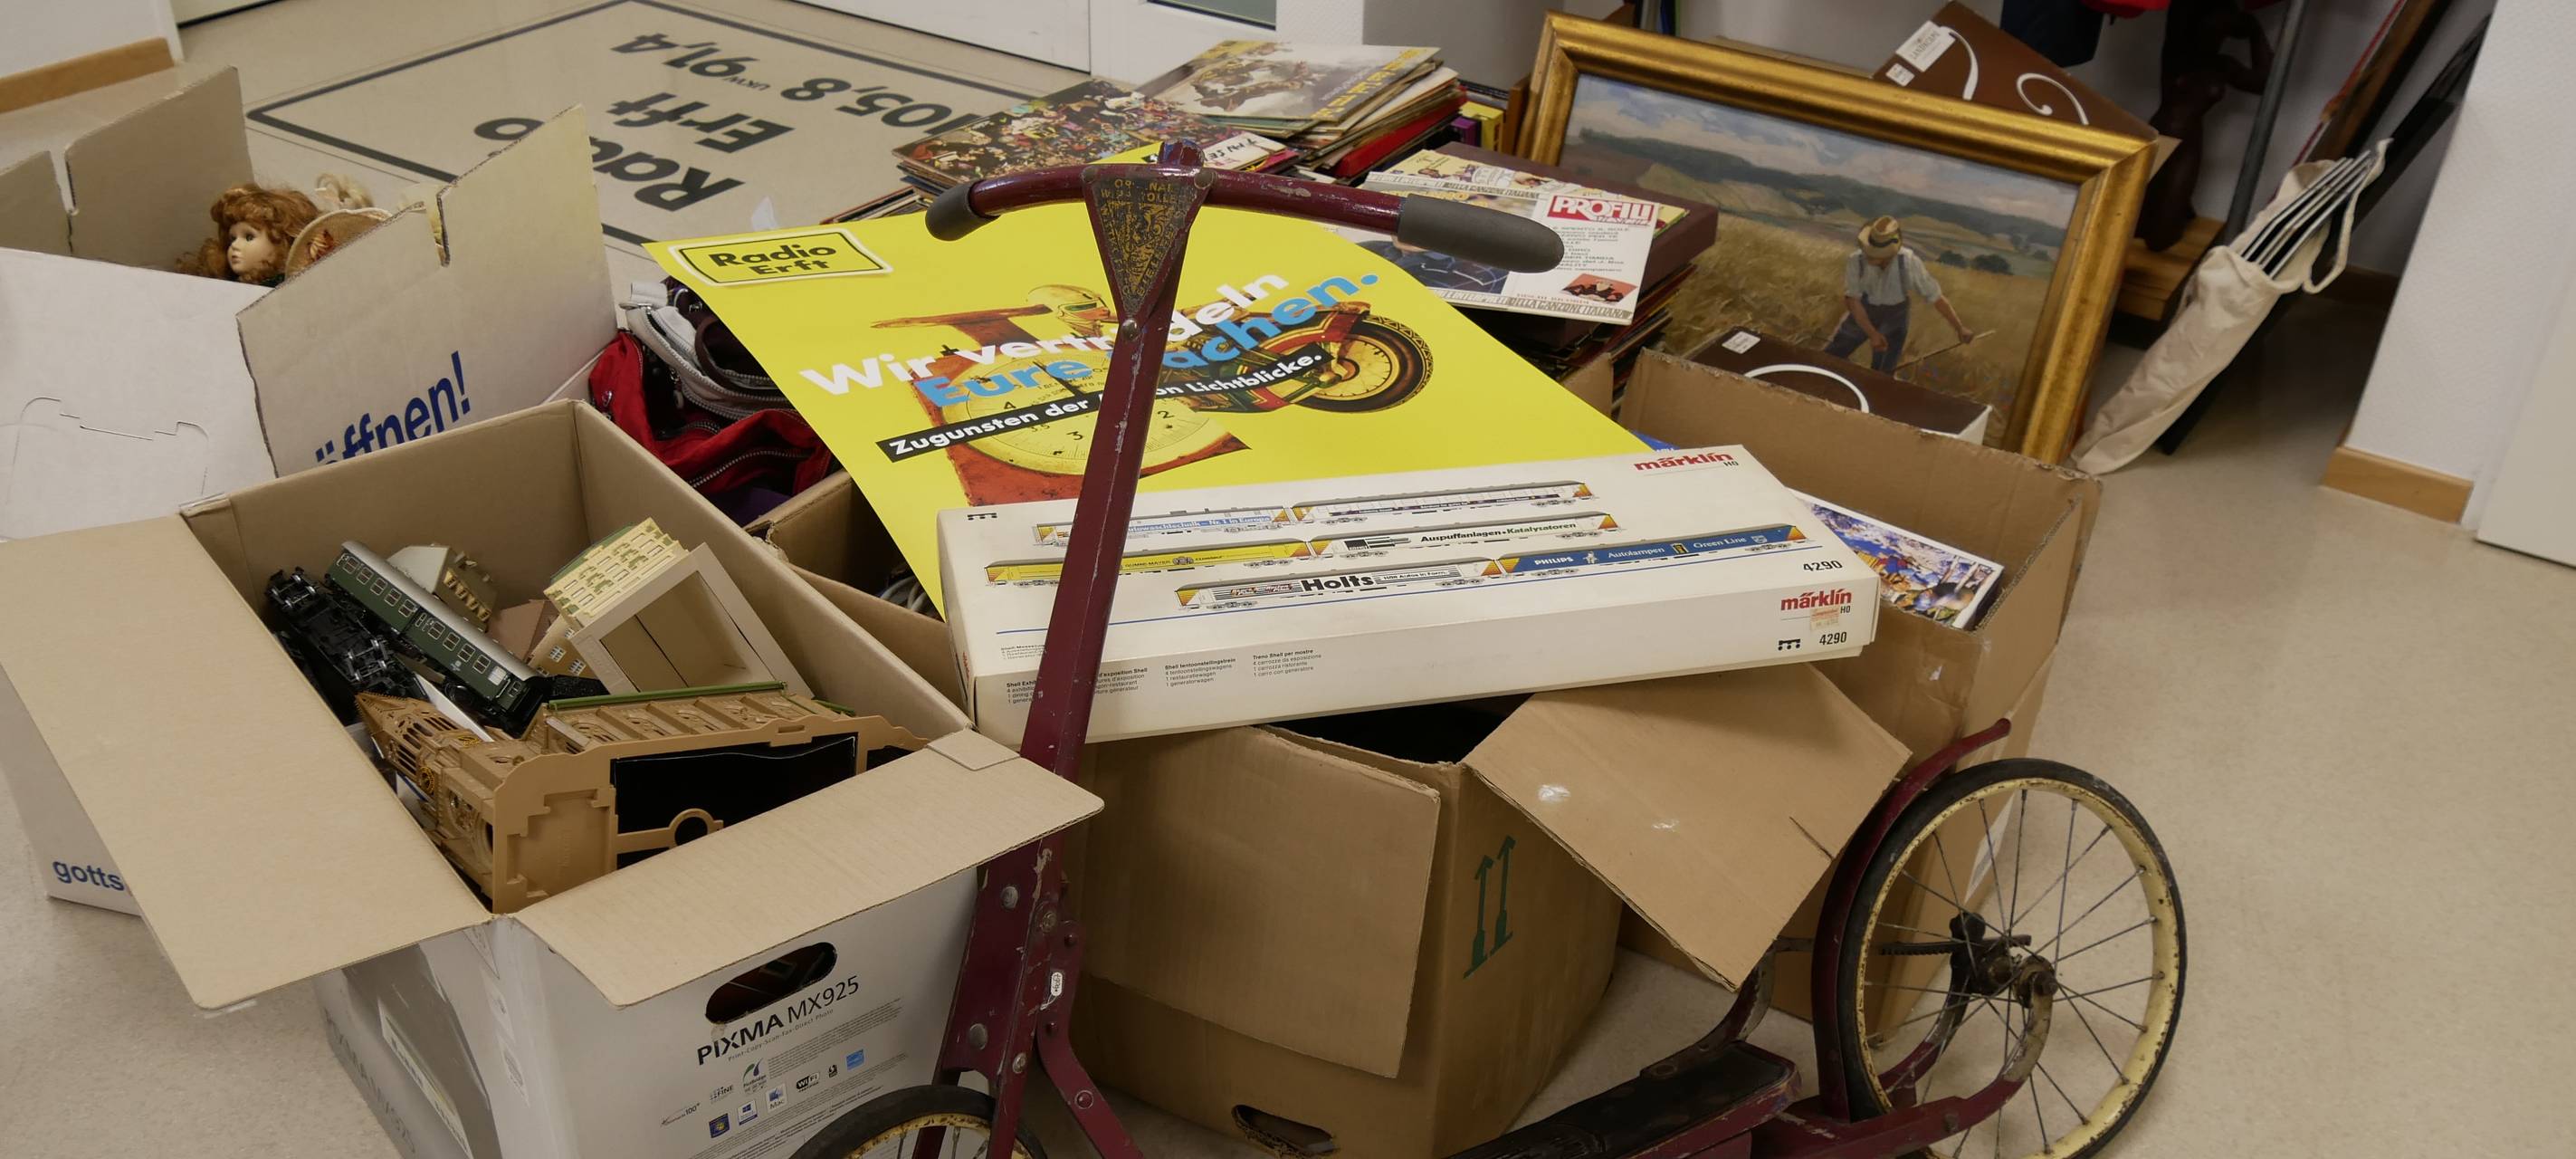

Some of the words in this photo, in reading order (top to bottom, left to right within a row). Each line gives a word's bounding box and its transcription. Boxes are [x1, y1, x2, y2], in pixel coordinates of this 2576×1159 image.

[611, 33, 760, 78] 91,4
[722, 76, 771, 91] UKW
[606, 91, 795, 153] Erft
[709, 244, 836, 267] Radio
[749, 259, 830, 274] Erft
[799, 353, 936, 396] Wir
[956, 272, 1289, 366] vertrdeln
[912, 359, 1093, 407] Eure
[1108, 273, 1379, 369] achen.
[1185, 353, 1322, 393] Lichtblicke.
[315, 350, 471, 465] ffnen!
[889, 409, 1041, 456] Zugunsten
[1045, 396, 1090, 418] der
[1239, 514, 1272, 523] Europa
[1421, 530, 1501, 543] Auspuffanlagen
[1506, 522, 1577, 535] Katalysatoren
[1534, 556, 1574, 566] PHILIPS
[1608, 547, 1665, 560] Autolampen
[1693, 541, 1723, 551] Green
[1725, 536, 1747, 546] Line
[1803, 560, 1844, 572] 4290
[1302, 575, 1375, 591] Holts
[1780, 589, 1853, 610] märklin
[1819, 631, 1847, 646] 4290
[1290, 654, 1321, 663] esposizione
[1284, 666, 1314, 675] generatore
[1097, 680, 1138, 689] gon-restaurant
[697, 1014, 784, 1066] PIXMA
[787, 975, 859, 1023] MX925
[769, 1099, 785, 1109] Mac
